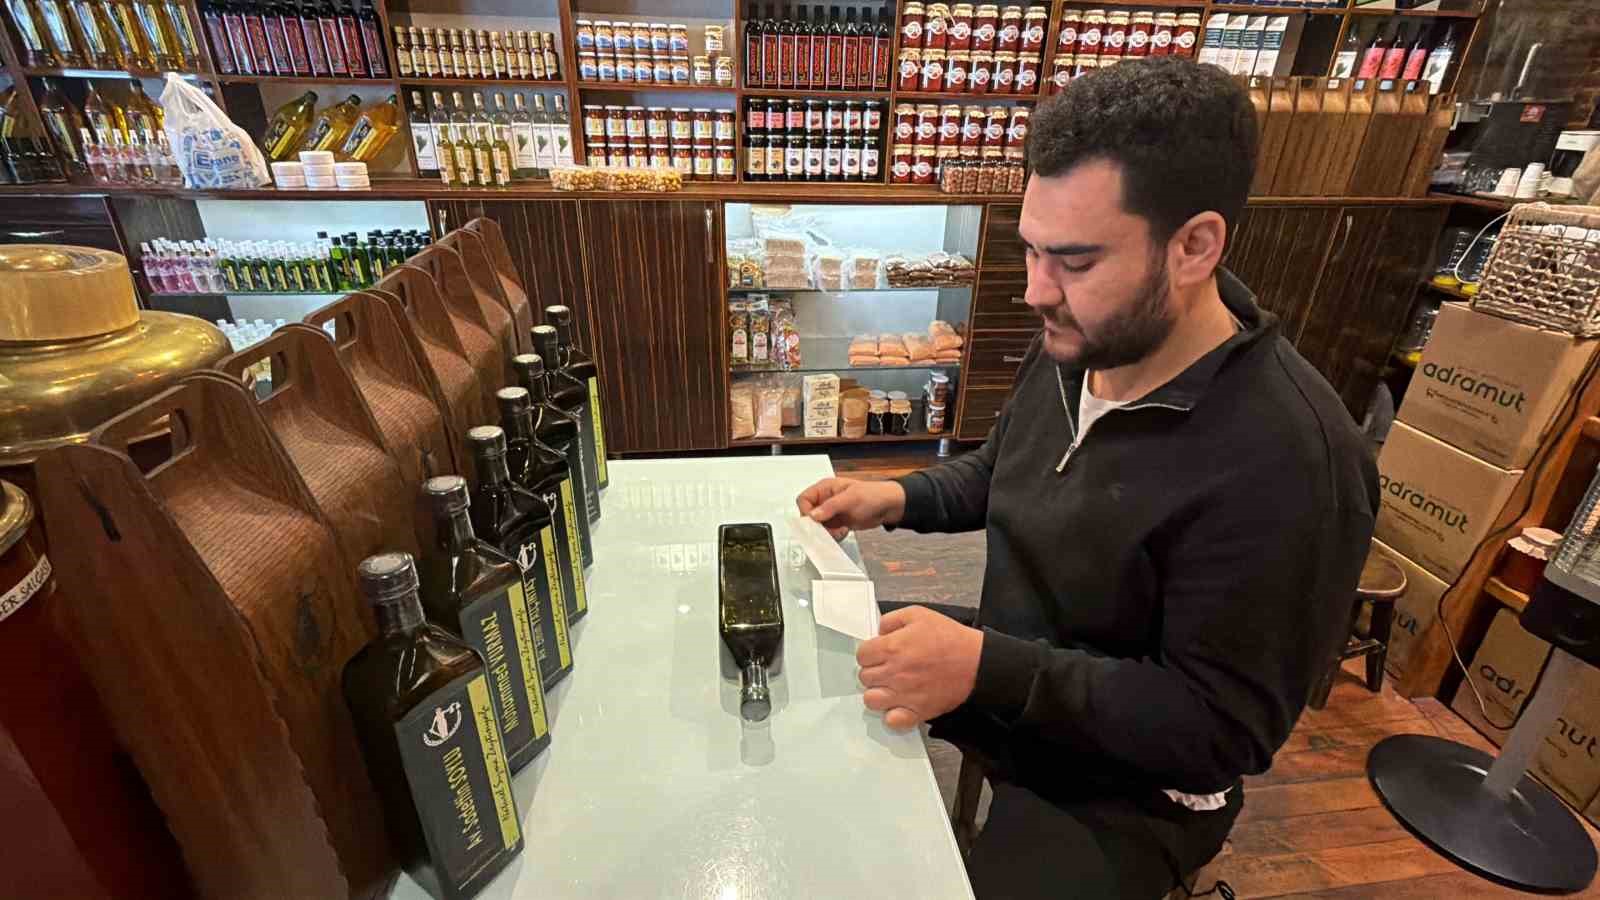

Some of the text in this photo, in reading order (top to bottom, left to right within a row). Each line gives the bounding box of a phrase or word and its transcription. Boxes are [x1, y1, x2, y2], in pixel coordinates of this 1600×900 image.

[1423, 362, 1526, 413] adramut
[1379, 474, 1468, 534] adramut
[496, 662, 520, 733] Muhammed
[442, 746, 469, 790] SOYLU
